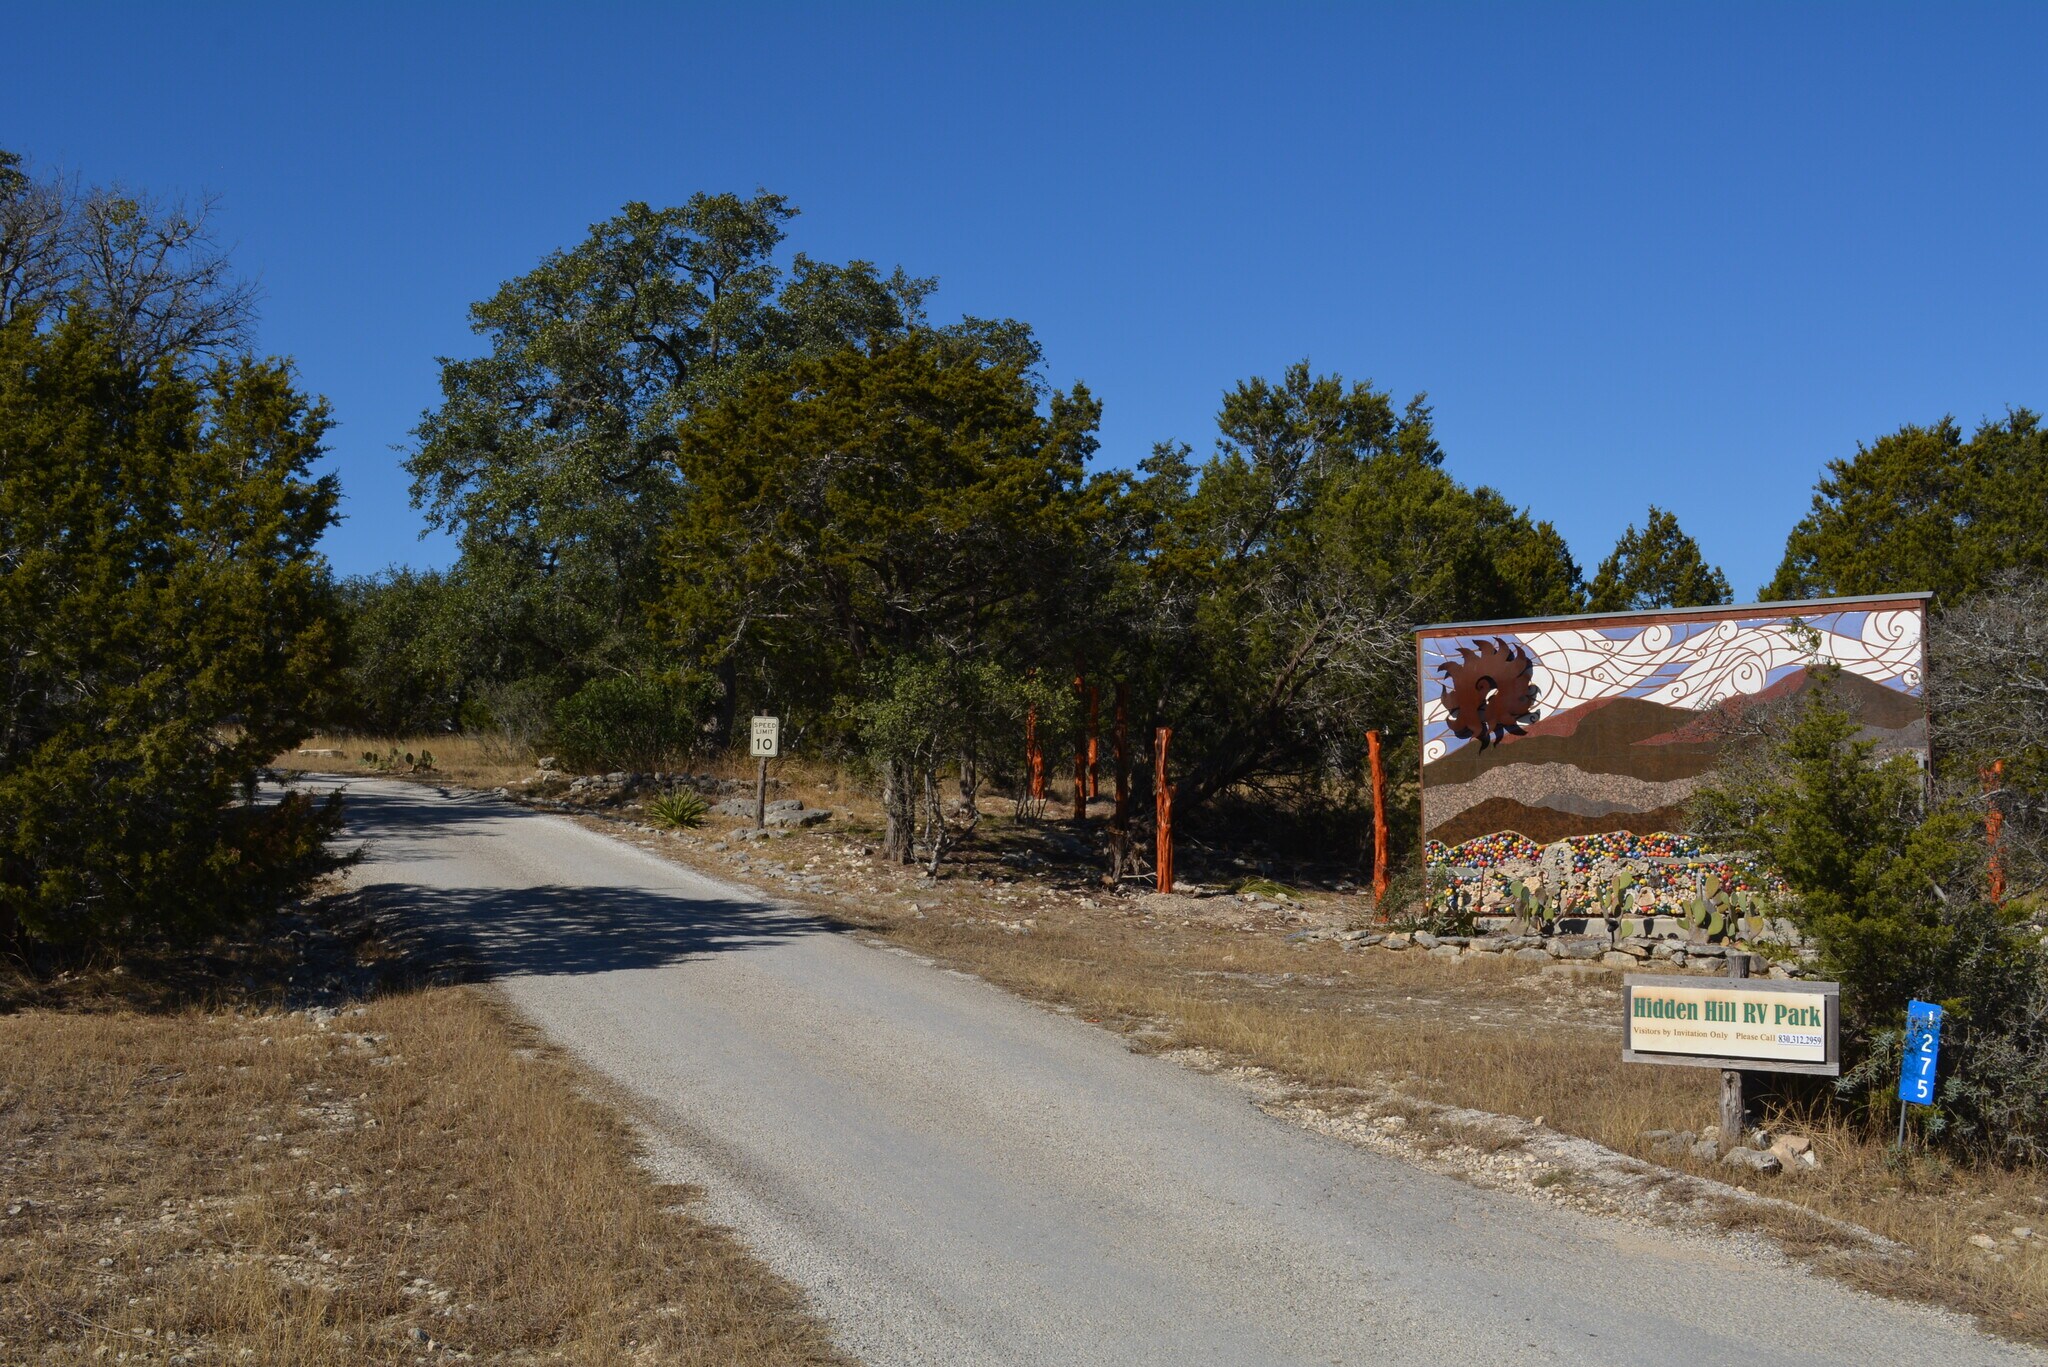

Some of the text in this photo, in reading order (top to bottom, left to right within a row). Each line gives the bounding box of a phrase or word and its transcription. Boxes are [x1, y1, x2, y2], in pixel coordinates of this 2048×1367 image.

[756, 738, 773, 750] 10
[1633, 997, 1821, 1028] Hidden Hill RV Park
[1633, 1027, 1661, 1035] Visitors
[1662, 1028, 1671, 1037] by
[1674, 1029, 1707, 1038] Invitation
[1710, 1031, 1728, 1040] Only
[1735, 1032, 1758, 1041] Please
[1760, 1034, 1776, 1042] Call
